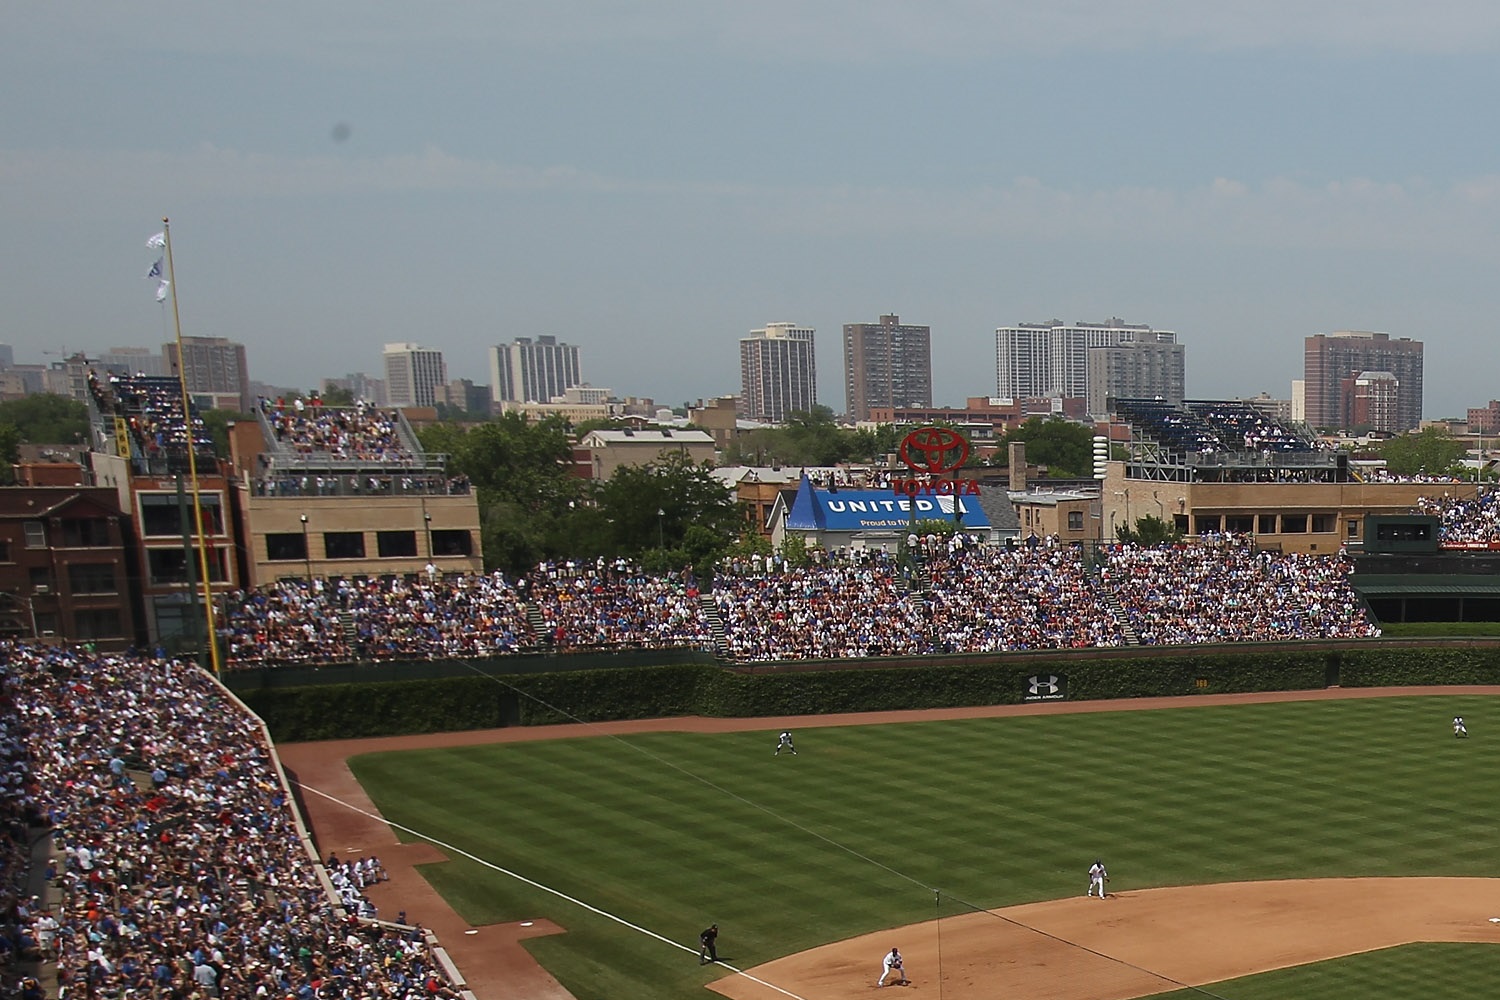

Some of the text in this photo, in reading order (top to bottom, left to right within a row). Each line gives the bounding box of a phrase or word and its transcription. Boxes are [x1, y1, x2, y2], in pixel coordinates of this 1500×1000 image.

[892, 479, 981, 496] TOYOTA
[828, 500, 933, 512] UNITED
[860, 519, 886, 527] Proud
[897, 519, 910, 527] fly
